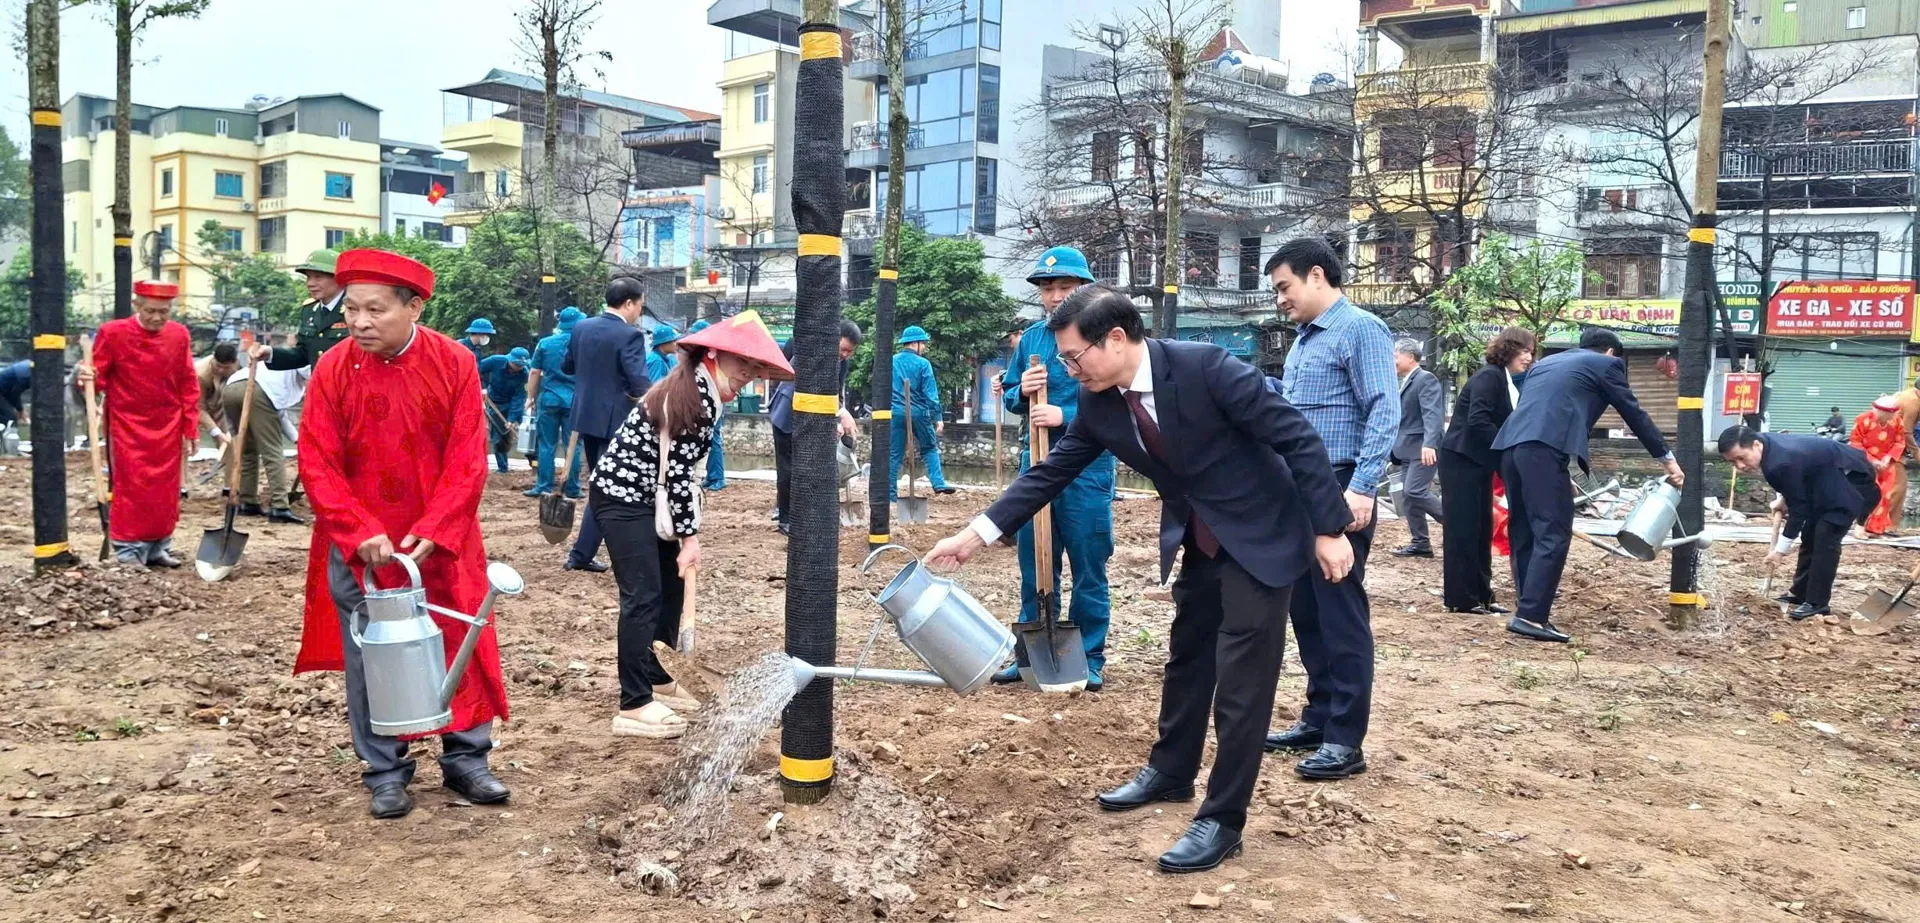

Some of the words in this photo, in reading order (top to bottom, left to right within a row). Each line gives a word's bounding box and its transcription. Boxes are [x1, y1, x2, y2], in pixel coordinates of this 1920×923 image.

[1717, 284, 1762, 295] HOND
[1879, 284, 1911, 294] DƯỠNG
[1777, 299, 1802, 316] XE
[1807, 299, 1831, 316] GA
[1848, 299, 1873, 316] XE
[1878, 294, 1905, 316] SỐ
[1776, 320, 1796, 328] MUA
[1797, 319, 1815, 328] BÁN
[1860, 320, 1872, 328] XE
[1886, 319, 1904, 328] MỚI
